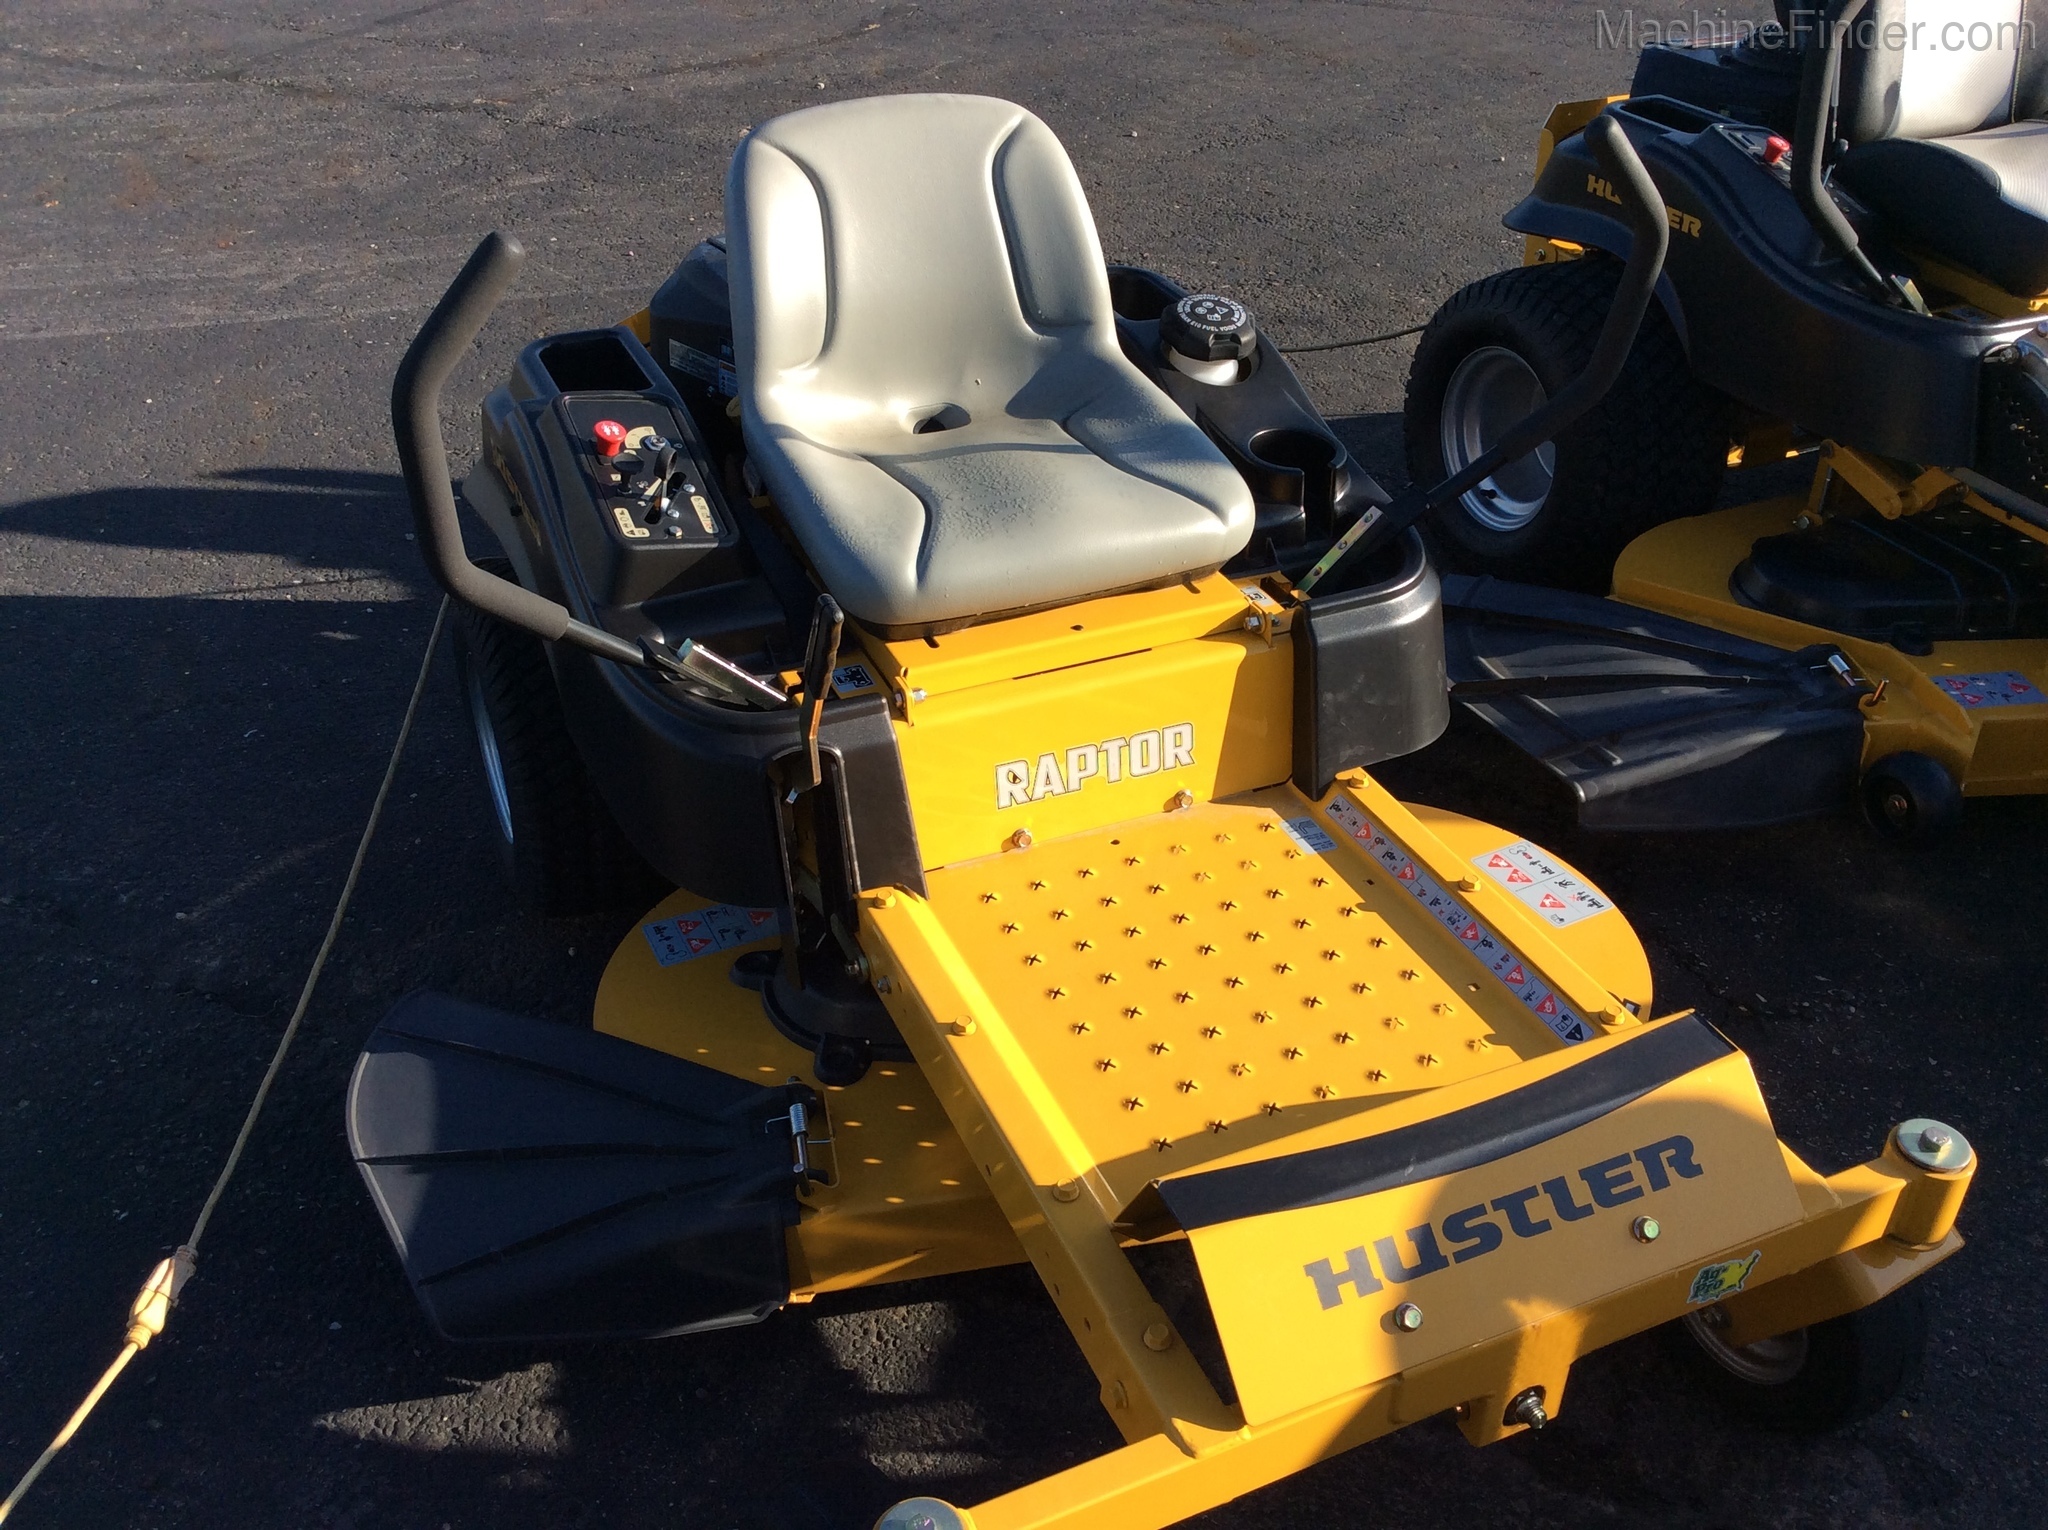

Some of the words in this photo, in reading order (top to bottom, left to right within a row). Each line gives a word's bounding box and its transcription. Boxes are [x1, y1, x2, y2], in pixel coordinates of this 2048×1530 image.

[1586, 173, 1702, 239] HUER
[995, 722, 1195, 809] RAPTOR
[1303, 1134, 1705, 1311] HUSTLER
